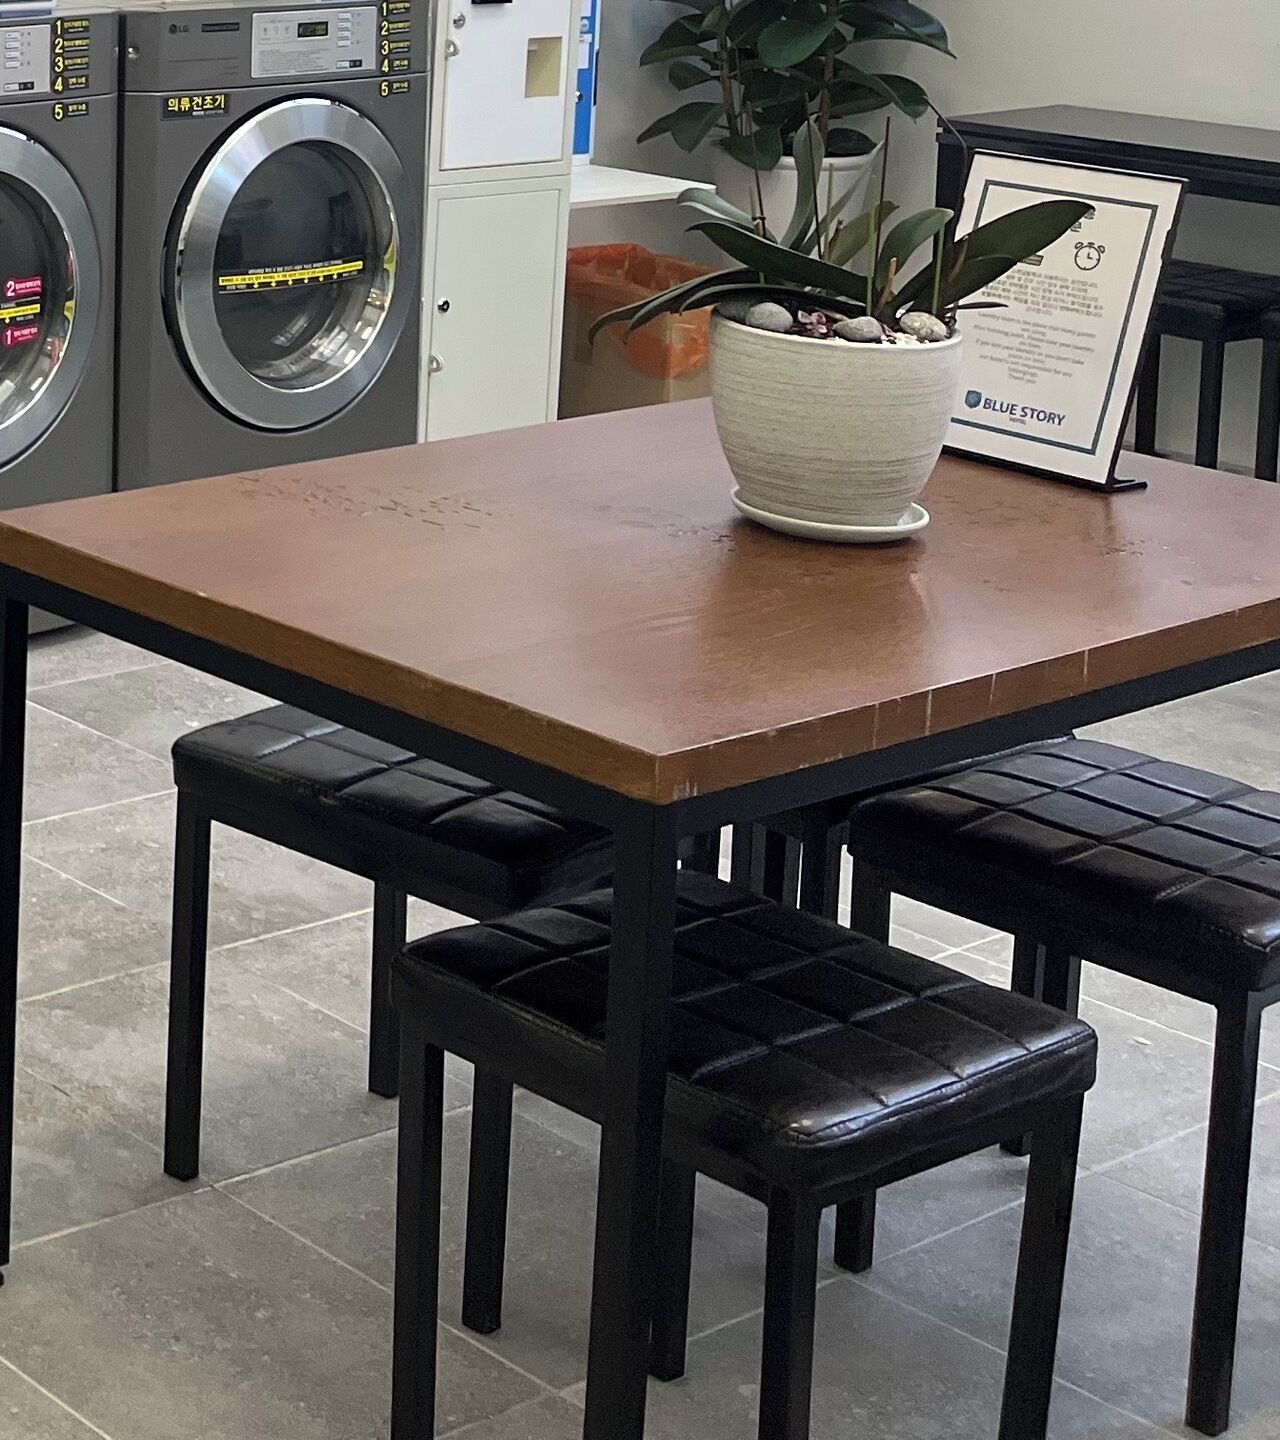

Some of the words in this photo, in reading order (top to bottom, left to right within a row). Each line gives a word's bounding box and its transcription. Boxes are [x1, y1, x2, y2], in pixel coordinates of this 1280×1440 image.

[382, 2, 387, 16] 1
[56, 20, 61, 35] 1
[381, 21, 388, 35] 2
[55, 38, 63, 53] 2
[381, 40, 389, 55] 3
[55, 57, 63, 72] 3
[381, 58, 389, 72] 4
[55, 77, 63, 91] 4
[381, 81, 388, 96] 5
[55, 104, 63, 119] 5
[7, 281, 15, 296] 2
[6, 329, 11, 344] 1
[983, 398, 1019, 416] BLUE
[1020, 406, 1066, 426] STORY
